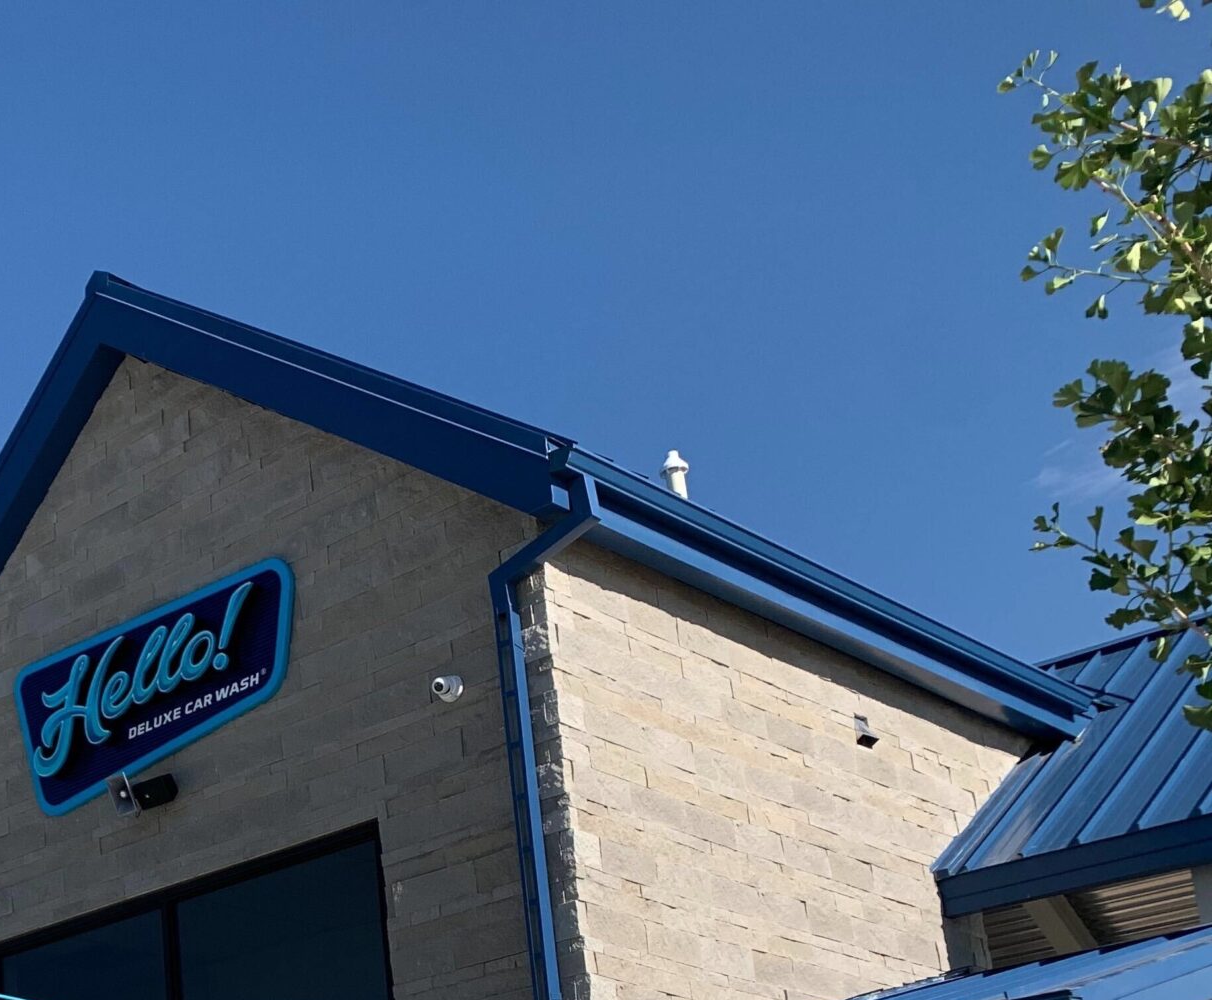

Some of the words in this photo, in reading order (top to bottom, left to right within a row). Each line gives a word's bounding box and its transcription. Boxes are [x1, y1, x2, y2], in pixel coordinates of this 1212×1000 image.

[33, 581, 253, 777] Hello!
[128, 706, 182, 740] DELUXE
[184, 693, 213, 715] CAR
